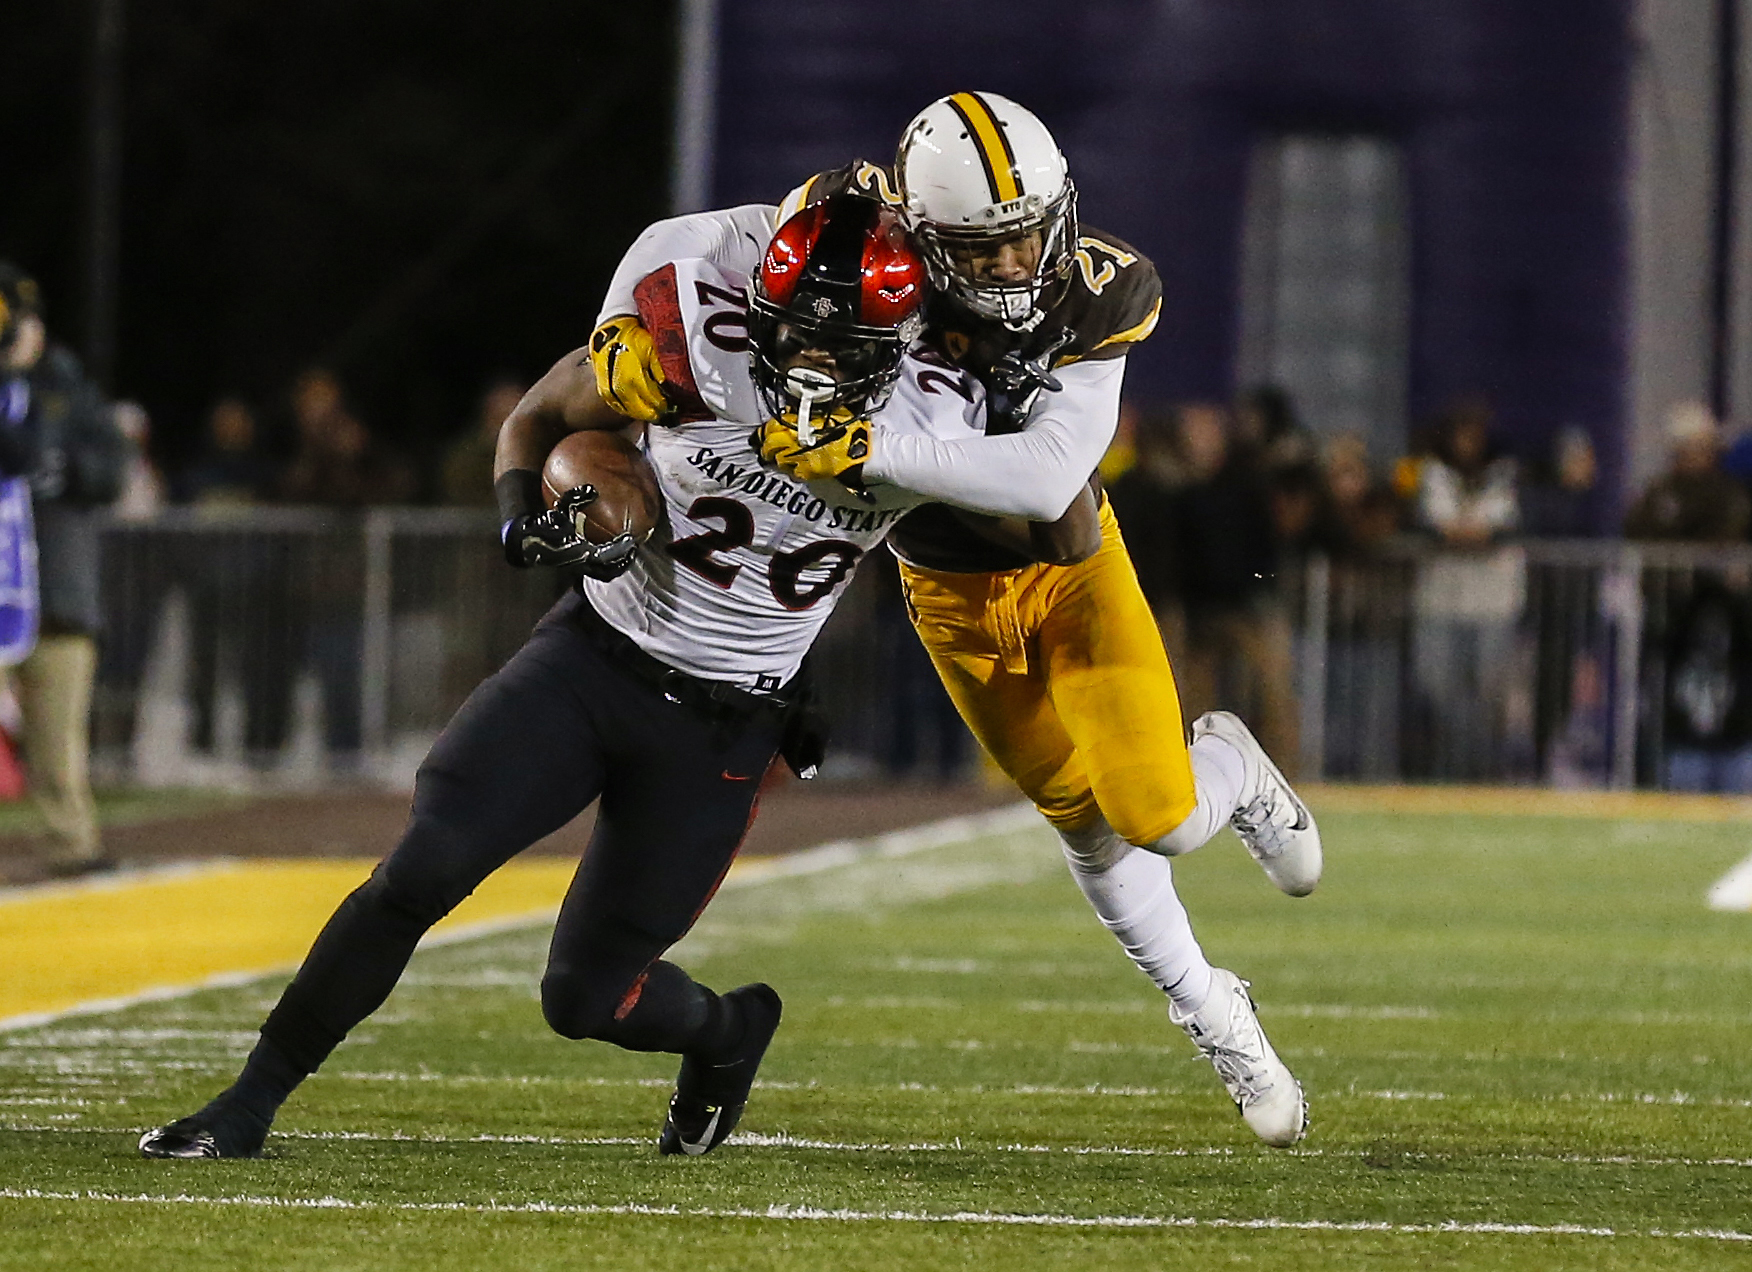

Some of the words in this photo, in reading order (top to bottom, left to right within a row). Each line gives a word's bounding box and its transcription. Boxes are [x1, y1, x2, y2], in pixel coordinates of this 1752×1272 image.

[1001, 201, 1020, 214] WYO
[1075, 236, 1138, 296] 21
[694, 281, 750, 352] 20
[687, 448, 748, 487] SAN
[740, 471, 826, 522] DIEGO
[666, 496, 864, 611] 20
